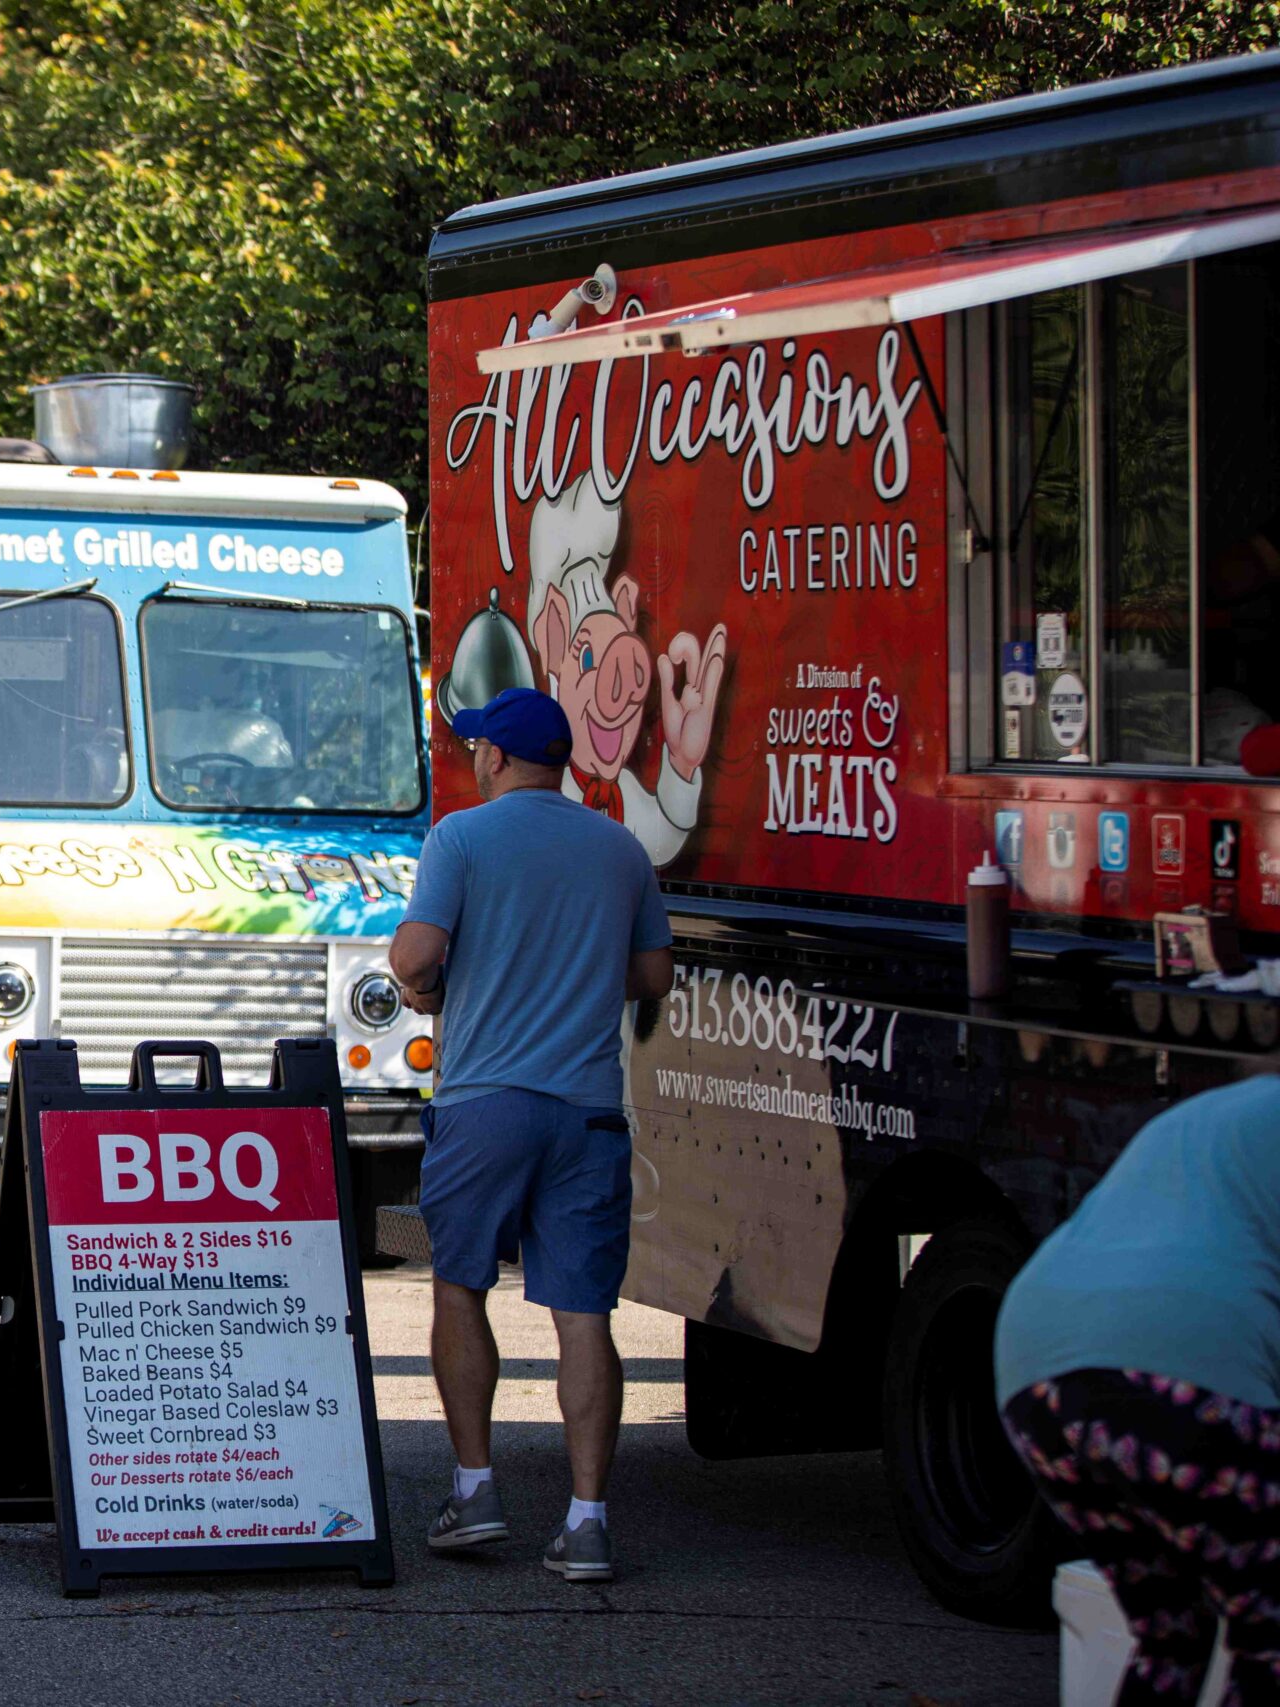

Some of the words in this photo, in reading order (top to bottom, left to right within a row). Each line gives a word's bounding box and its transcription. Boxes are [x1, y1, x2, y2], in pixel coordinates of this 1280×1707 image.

[447, 312, 580, 574] All
[591, 295, 922, 508] Occasions
[74, 527, 199, 571] Grilled
[209, 534, 345, 577] Cheese
[739, 522, 918, 593] CATERING
[796, 663, 806, 689] A
[807, 663, 850, 689] Division
[851, 662, 864, 689] of
[766, 695, 854, 747] sweets
[863, 676, 900, 748] &
[764, 753, 898, 843] MEATS
[669, 963, 900, 1072] 513.888.4227
[656, 1068, 917, 1141] www.sweetsandmeatsbbq.com
[97, 1130, 280, 1213] BBQ
[67, 1233, 158, 1250] Sandwich
[164, 1232, 177, 1249] &
[182, 1232, 193, 1248] 2
[200, 1230, 252, 1248] Sides
[257, 1228, 292, 1249] $16
[71, 1254, 112, 1272] BBQ
[118, 1253, 177, 1273] 4-Way
[183, 1250, 219, 1270] $13
[72, 1273, 165, 1292] Individual
[171, 1272, 224, 1290] Menu
[230, 1271, 289, 1288] Items:
[75, 1301, 133, 1319] Pulled
[140, 1300, 183, 1317] Pork
[187, 1298, 278, 1317] Sandwich
[283, 1296, 306, 1316] $9
[77, 1321, 135, 1339] Pulled
[140, 1320, 214, 1337] Chicken
[220, 1317, 309, 1336] Sandwich
[315, 1315, 337, 1335] $9
[79, 1345, 120, 1362] Mac
[125, 1345, 139, 1361] n'
[145, 1343, 214, 1361] Cheese
[220, 1340, 243, 1360] $5
[82, 1365, 140, 1382] Baked
[146, 1364, 204, 1381] Beans
[210, 1361, 233, 1381] $4
[84, 1384, 154, 1402] Loaded
[160, 1383, 221, 1401] Potato
[227, 1380, 279, 1399] Salad
[284, 1378, 308, 1398] $4
[84, 1405, 156, 1426] Vinegar
[162, 1402, 220, 1421] Based
[226, 1400, 310, 1419] Coleslaw
[316, 1397, 339, 1418] $3
[87, 1427, 145, 1446] Sweet
[150, 1424, 248, 1444] Cornbread
[253, 1422, 276, 1442] $3
[89, 1453, 129, 1466] Other
[133, 1451, 171, 1465] sides
[175, 1450, 217, 1464] rotate
[222, 1447, 280, 1463] $4/each
[91, 1473, 117, 1486] Our
[120, 1470, 185, 1485] Desserts
[189, 1469, 231, 1483] rotate
[235, 1466, 294, 1482] $6/each
[95, 1495, 139, 1513] Cold
[145, 1493, 206, 1512] Drinks
[211, 1494, 300, 1512] (water/soda)
[96, 1528, 120, 1542] We
[123, 1525, 170, 1544] accept
[173, 1523, 206, 1540] cash
[209, 1523, 223, 1539] &
[226, 1522, 269, 1538] credit
[271, 1520, 317, 1537] cards!
